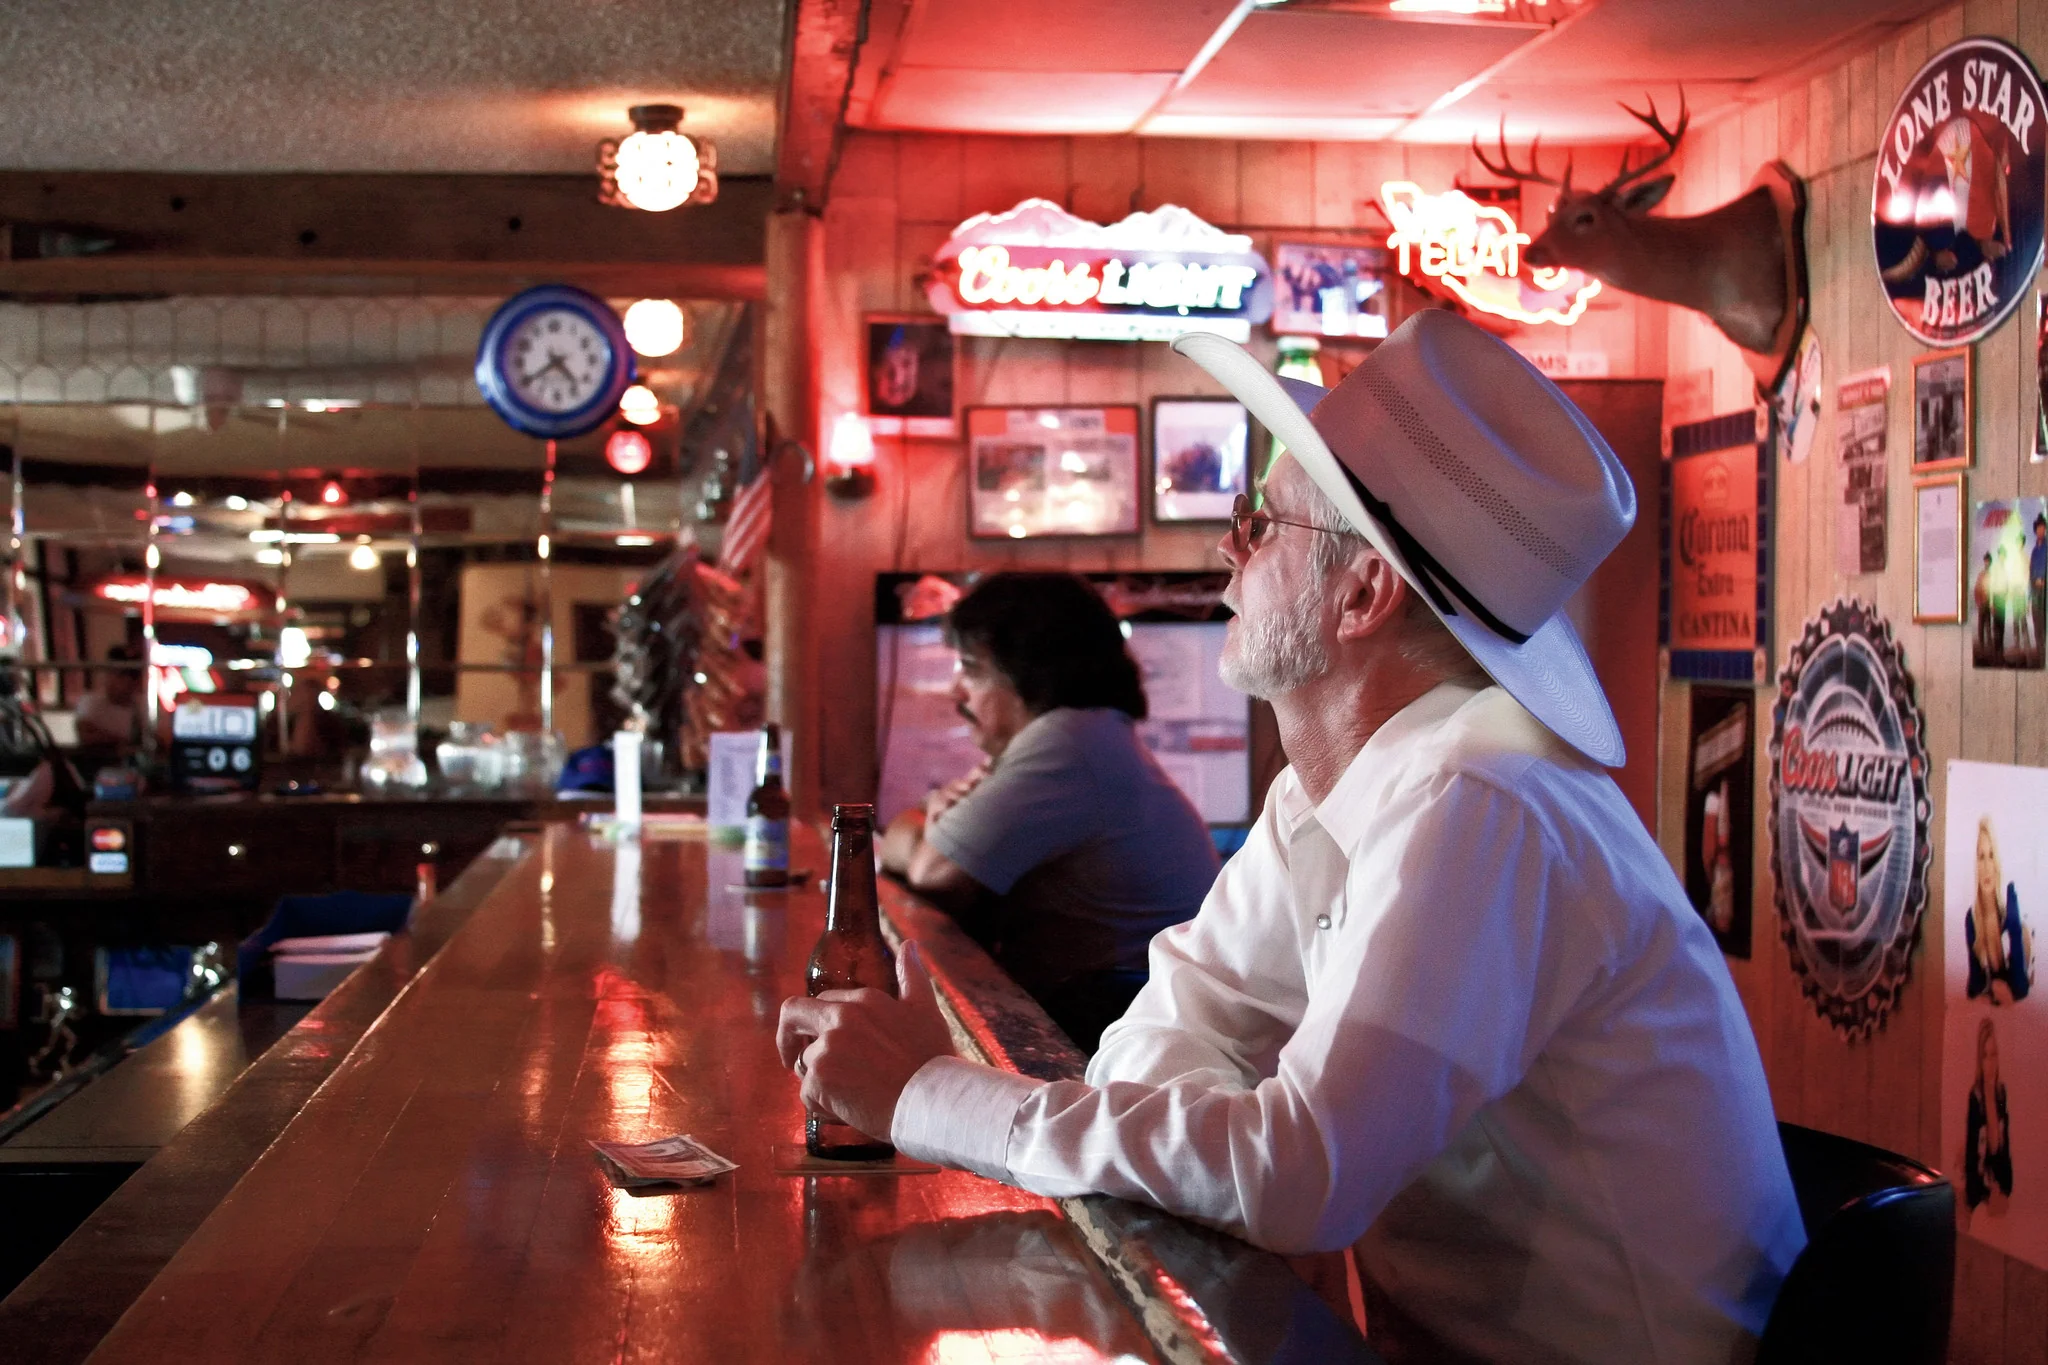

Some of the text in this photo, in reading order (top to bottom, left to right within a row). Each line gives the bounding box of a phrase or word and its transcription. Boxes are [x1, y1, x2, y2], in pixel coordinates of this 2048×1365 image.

[1881, 59, 2035, 196] LONE STAR
[958, 245, 1257, 310] Coors LIGHT
[1920, 262, 1999, 326] BEER
[1680, 508, 1750, 567] Corona
[1782, 724, 1838, 798] Coors
[1837, 750, 1908, 805] LIGHT
